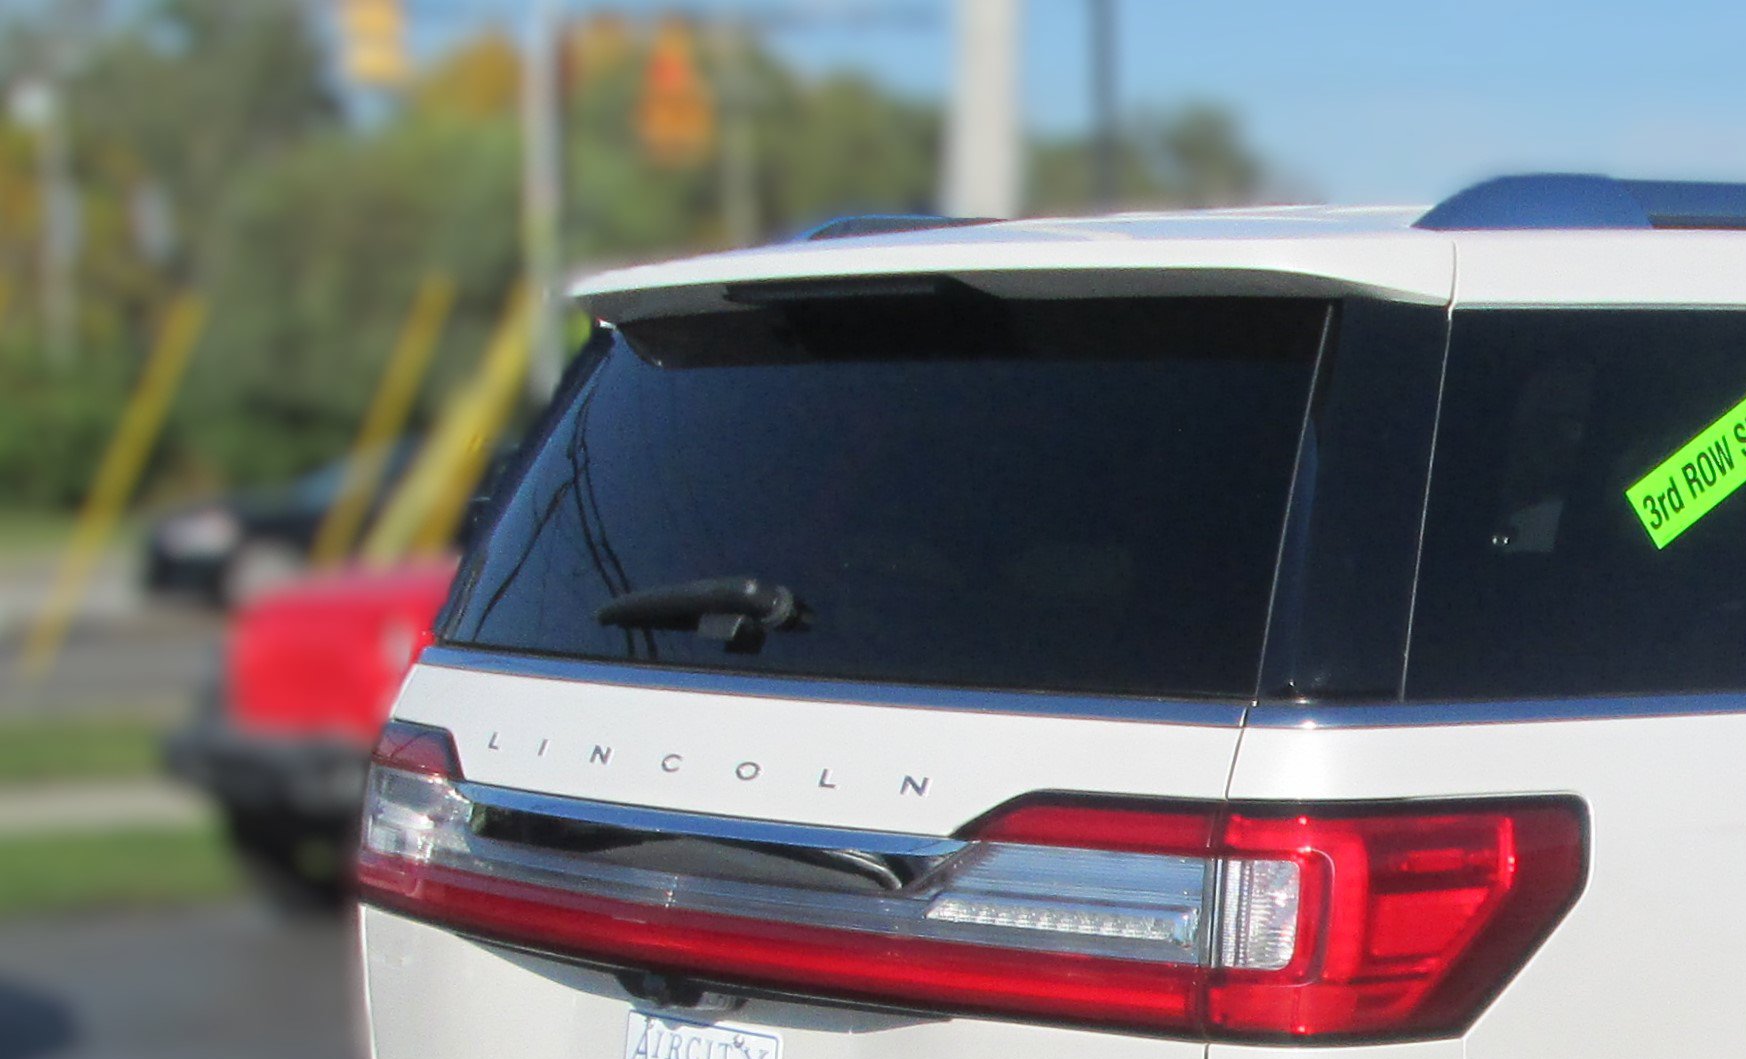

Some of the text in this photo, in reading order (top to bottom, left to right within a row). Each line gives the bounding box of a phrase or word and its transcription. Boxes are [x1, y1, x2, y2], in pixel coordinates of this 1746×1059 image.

[1643, 476, 1685, 530] 3rd
[1681, 435, 1735, 500] ROW
[487, 731, 931, 797] LINCOLN
